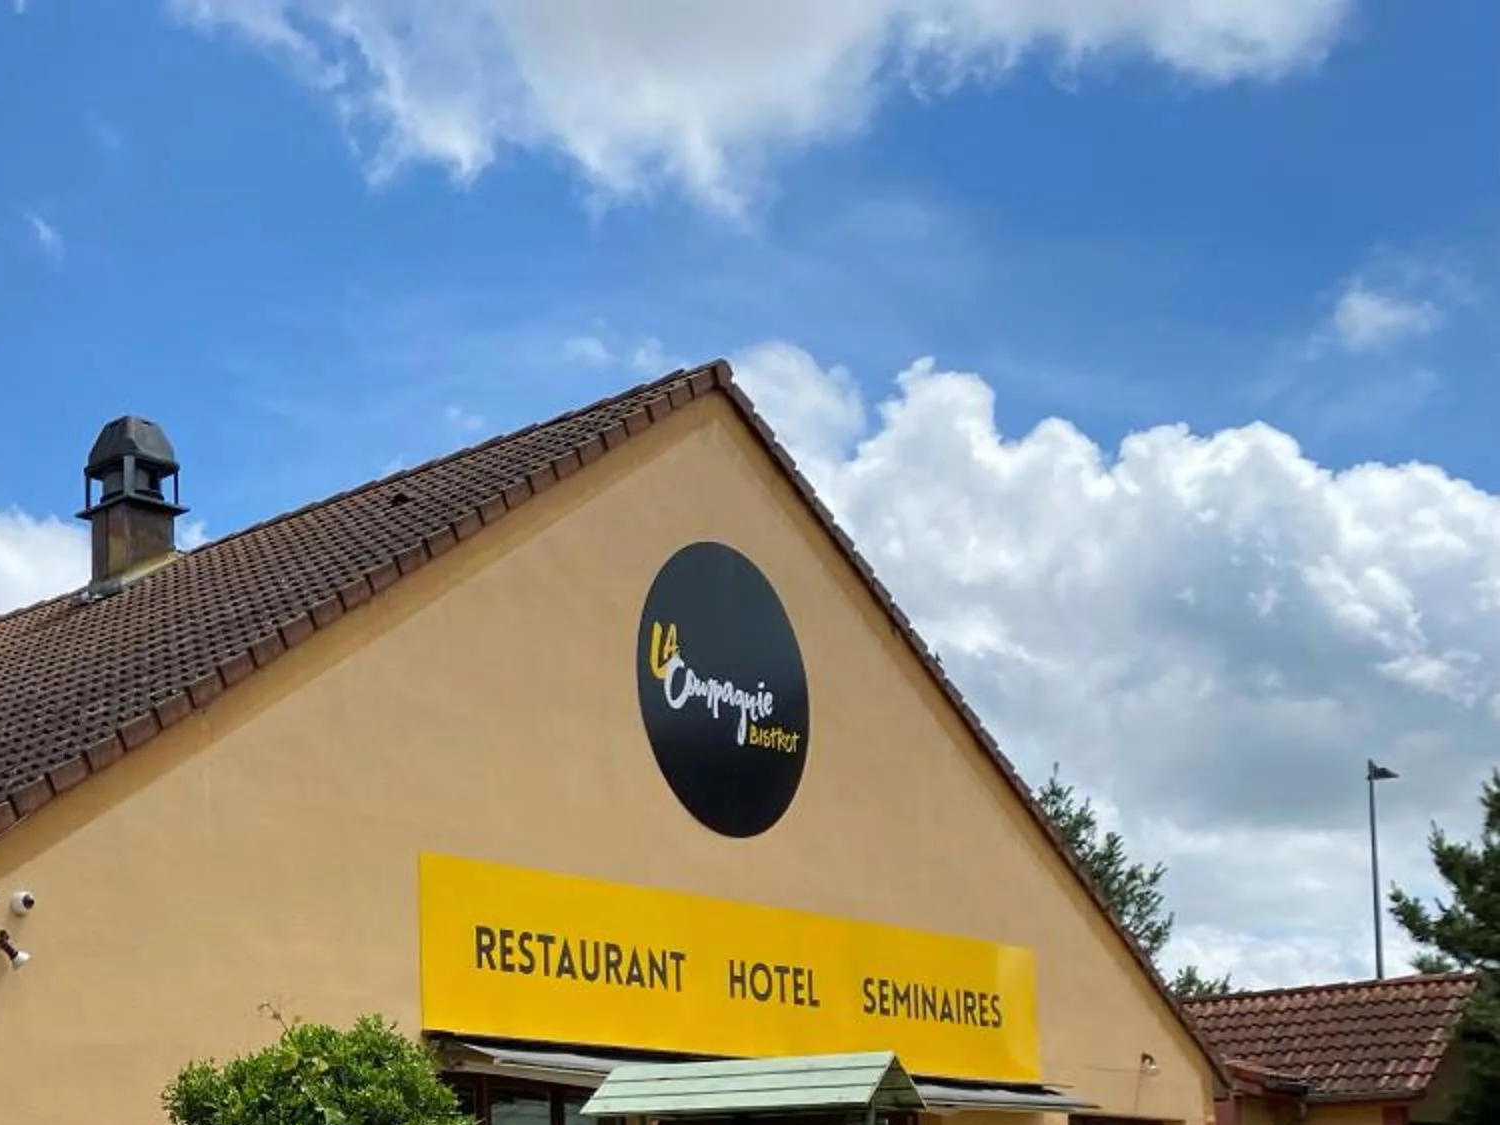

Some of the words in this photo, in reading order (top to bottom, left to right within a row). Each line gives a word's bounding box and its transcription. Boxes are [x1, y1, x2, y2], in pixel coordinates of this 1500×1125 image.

[664, 653, 773, 746] Compagnie
[474, 925, 686, 992] RESTAURANT
[728, 959, 820, 1008] HOTEL
[862, 976, 1003, 1029] SEMINAIRES
